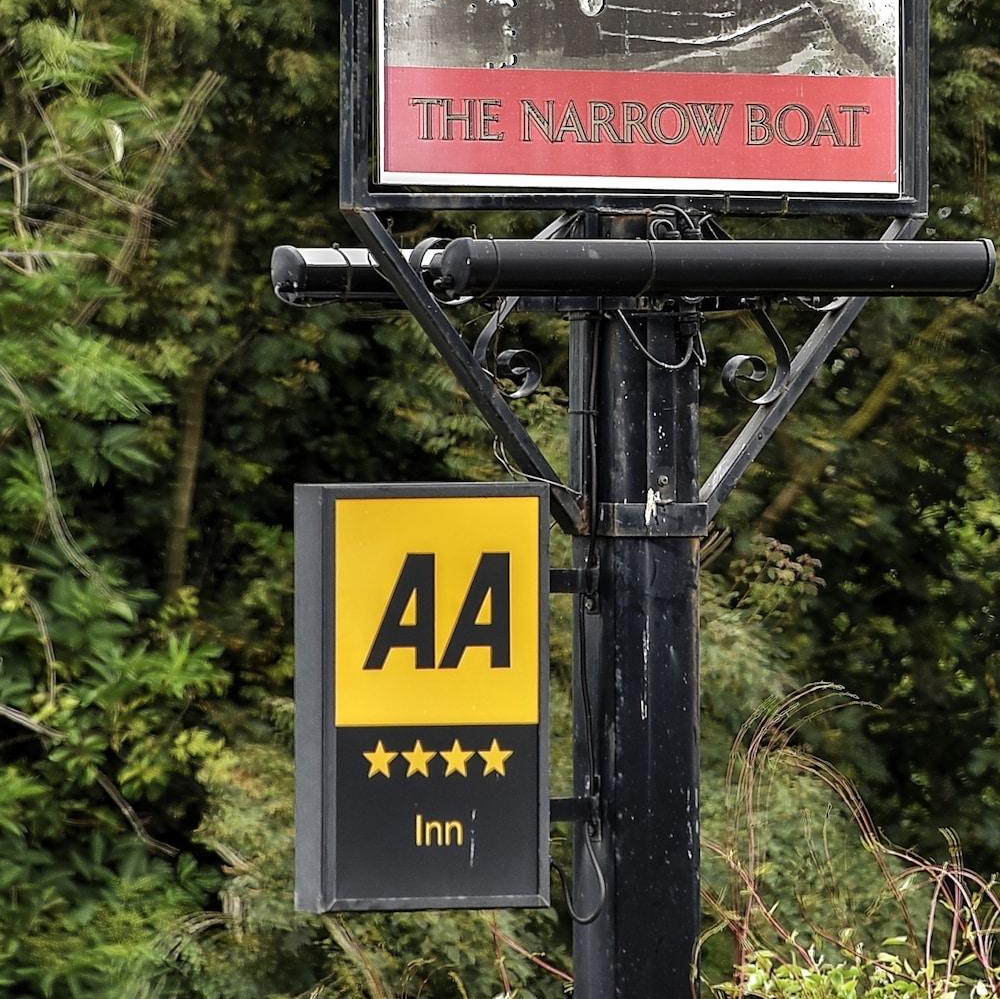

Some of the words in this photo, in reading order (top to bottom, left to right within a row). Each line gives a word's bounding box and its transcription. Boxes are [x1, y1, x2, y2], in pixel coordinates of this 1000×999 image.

[409, 97, 505, 143] THE
[520, 99, 733, 147] NARROW
[744, 103, 871, 149] BOAT
[362, 552, 511, 670] AA
[415, 813, 464, 847] Inn
